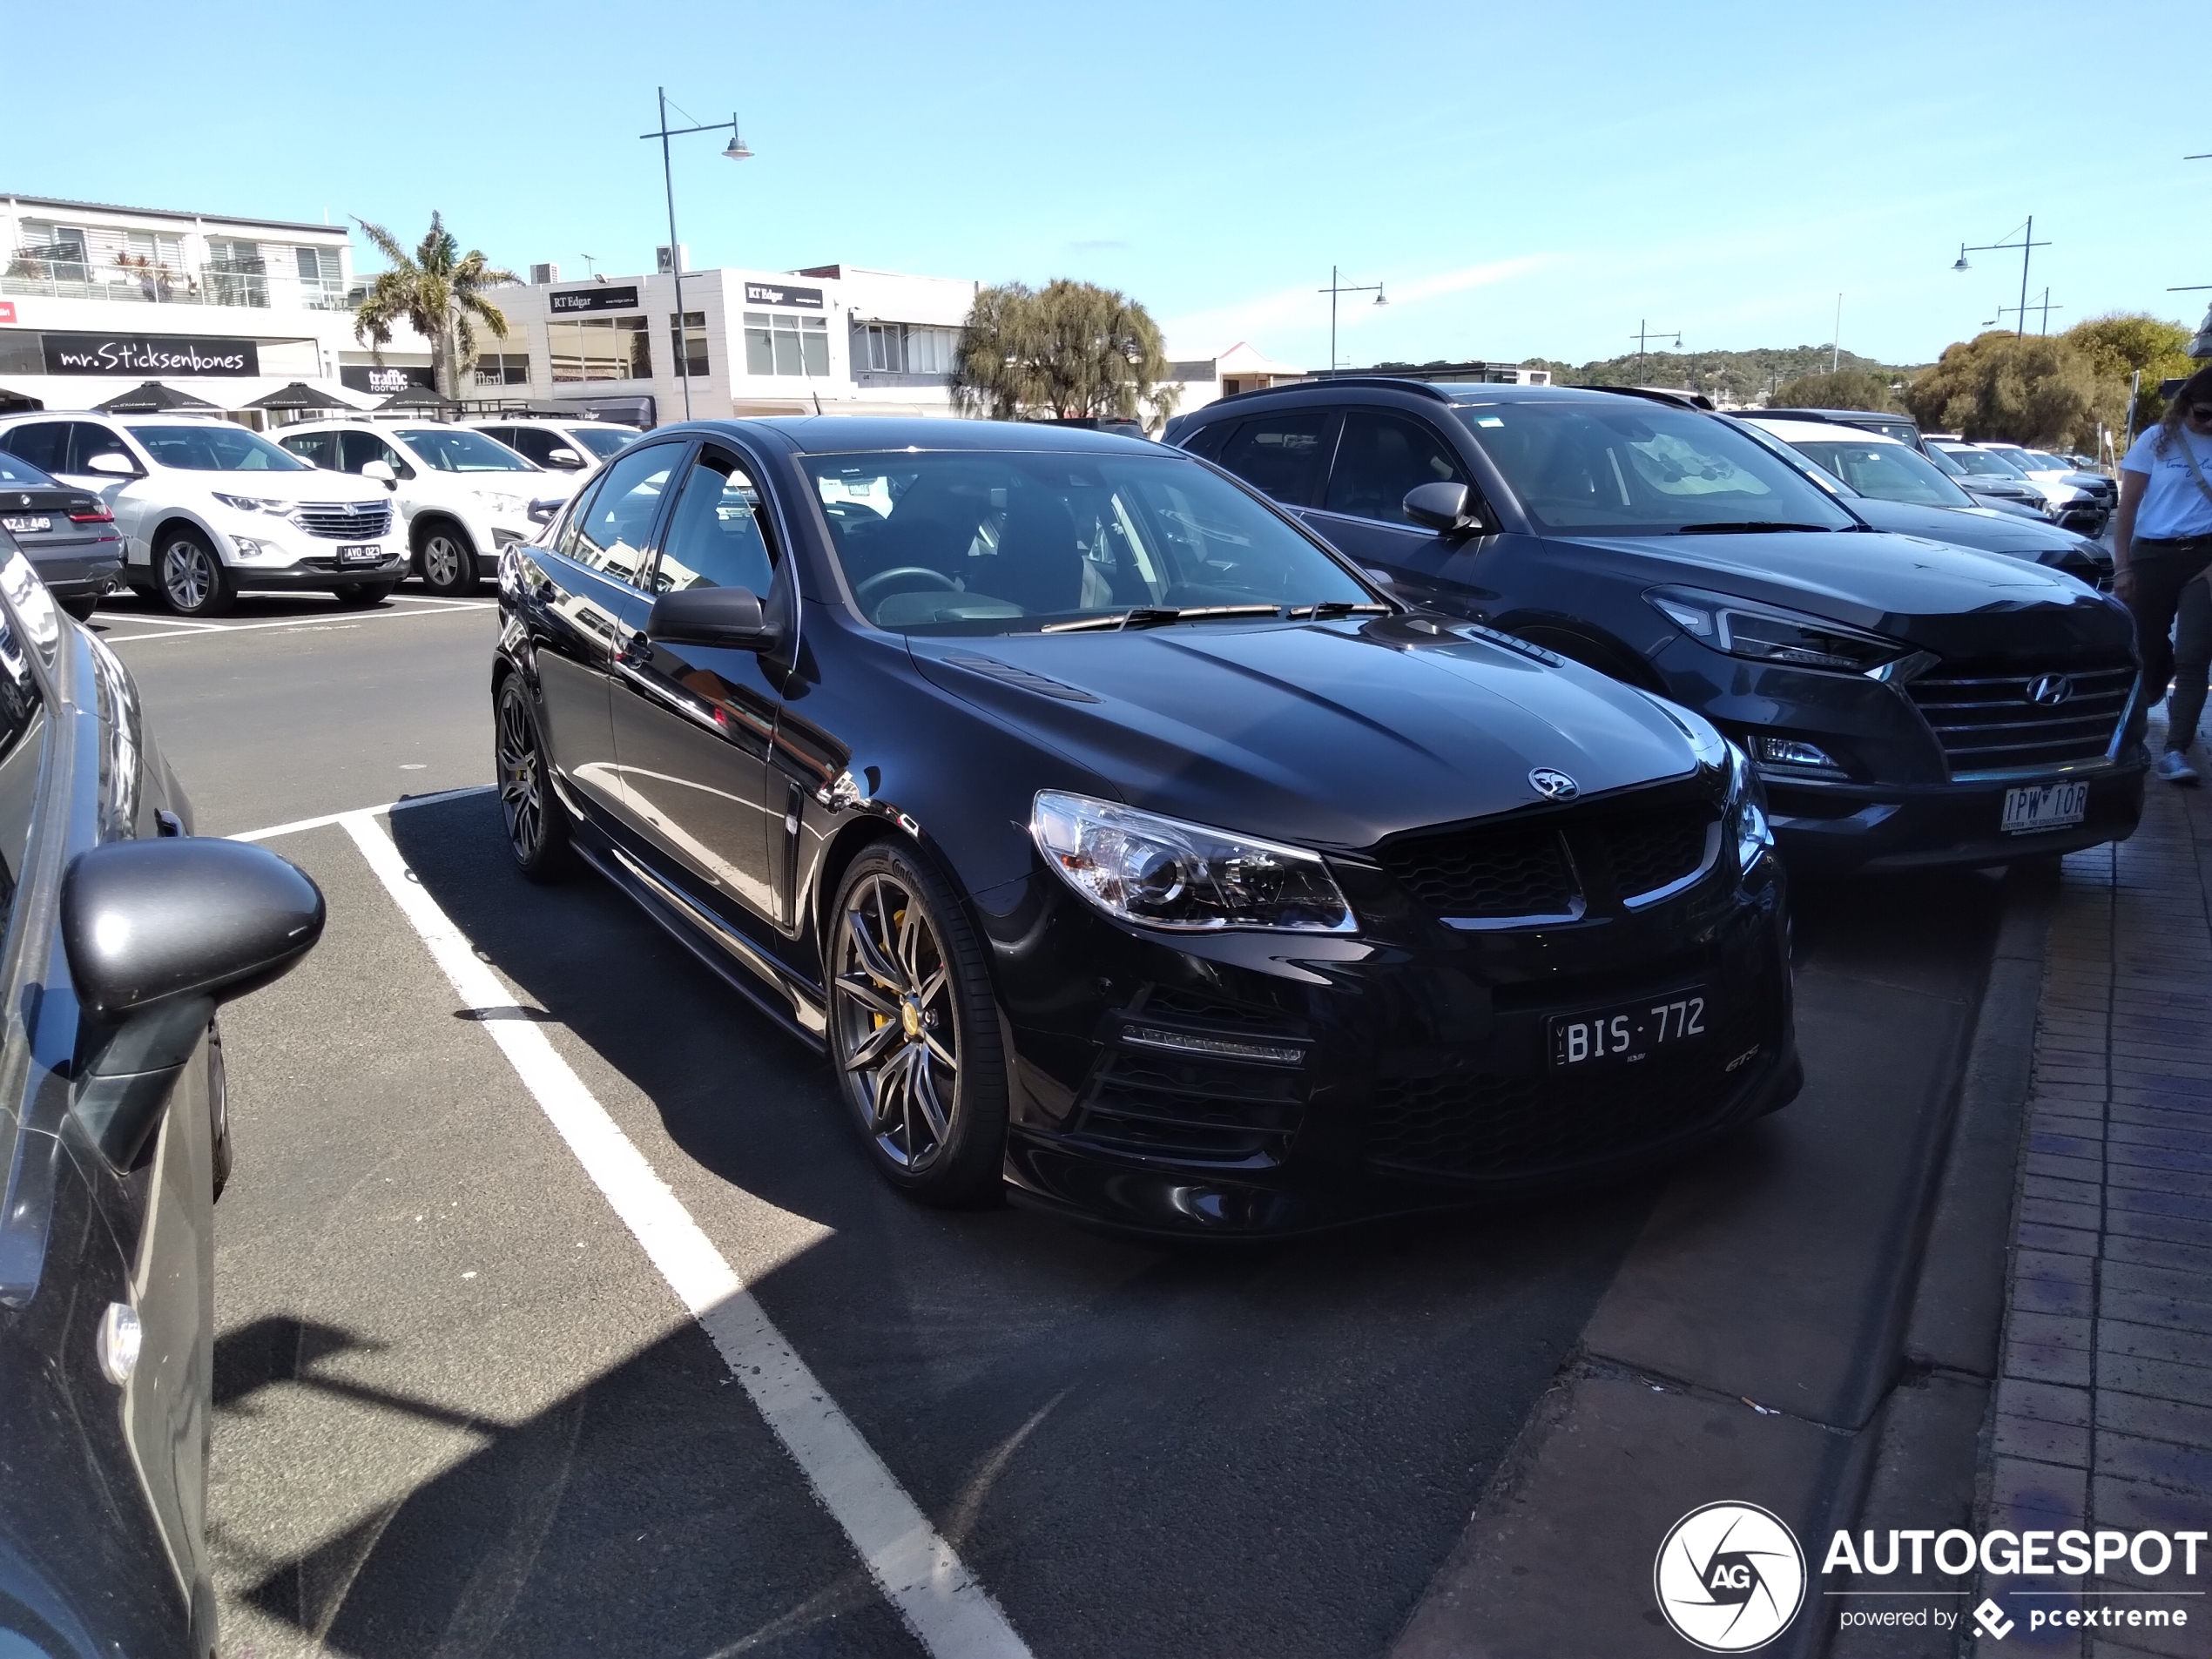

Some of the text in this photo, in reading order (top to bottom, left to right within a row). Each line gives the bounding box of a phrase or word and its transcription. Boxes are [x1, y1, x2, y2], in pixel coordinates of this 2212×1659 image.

[554, 296, 591, 308] RT Edgar
[761, 288, 784, 303] Edgar
[369, 369, 408, 385] traffic
[30, 517, 51, 529] 449
[365, 546, 381, 556] 023
[2007, 791, 2041, 821] 1PW
[1568, 997, 1705, 1062] BIS 772
[1556, 1026, 1565, 1065] VIC
[1725, 1043, 1760, 1073] GTS
